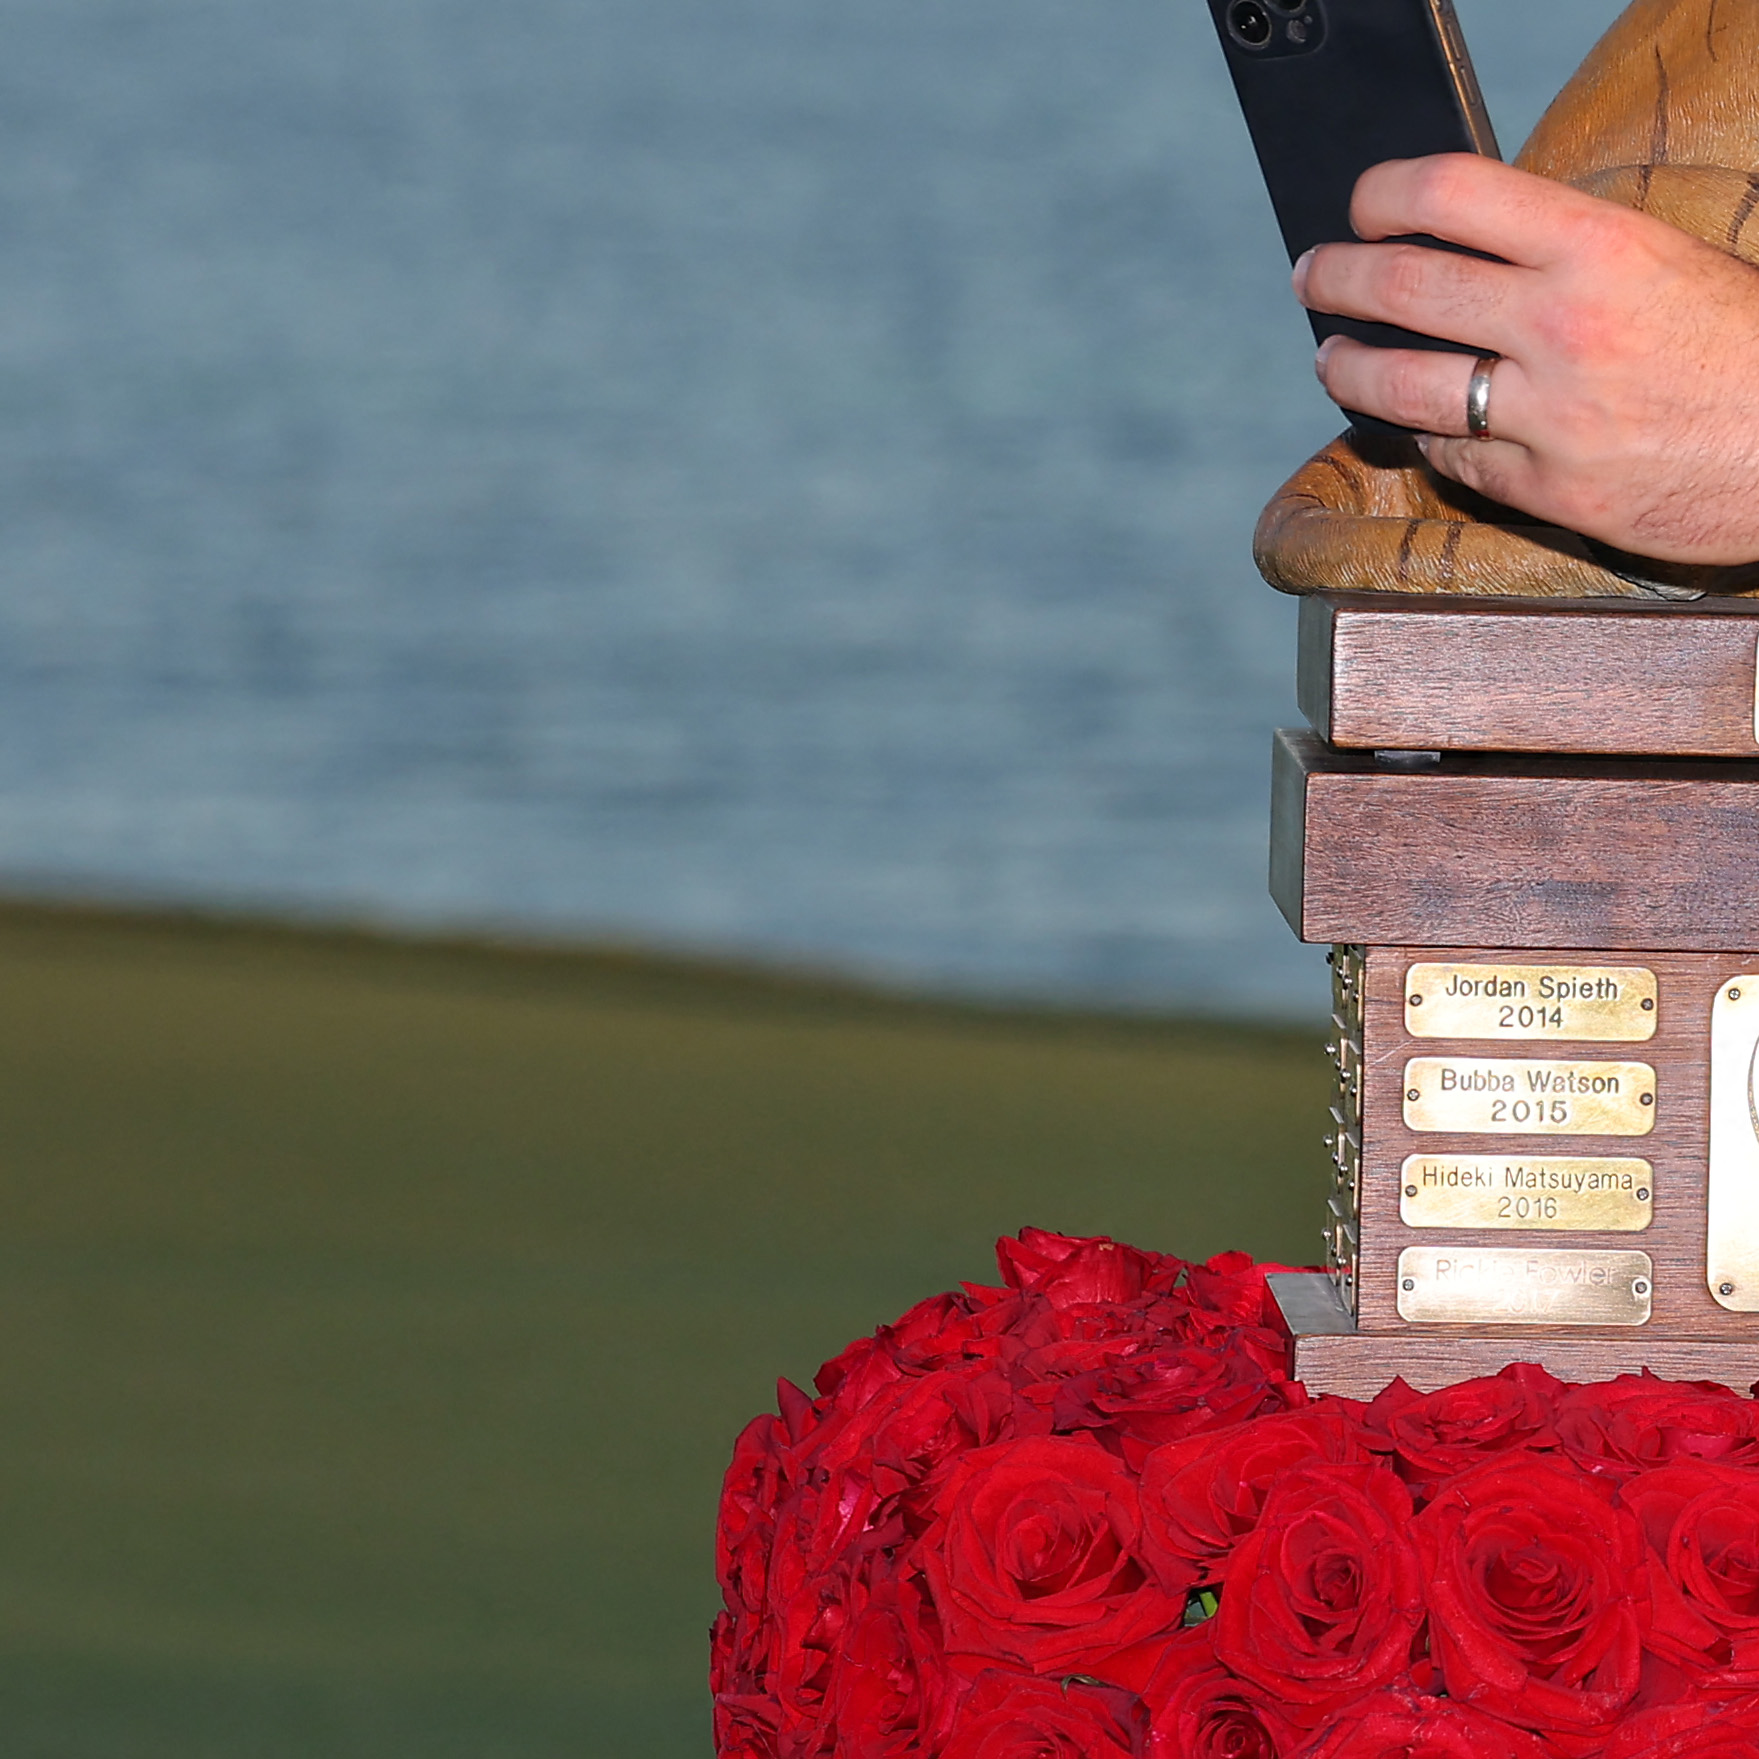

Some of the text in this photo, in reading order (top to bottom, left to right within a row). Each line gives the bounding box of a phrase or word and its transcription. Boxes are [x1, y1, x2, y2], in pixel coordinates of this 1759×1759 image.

[1446, 975, 1618, 1002] Jordan Spieth
[1499, 1006, 1563, 1028] 2014
[1441, 1069, 1619, 1094] Bubba Watson
[1491, 1100, 1568, 1123] 2015
[1422, 1166, 1633, 1193] Hideki Matsuyama
[1498, 1197, 1557, 1219] 2016
[1526, 1260, 1616, 1285] Fowler
